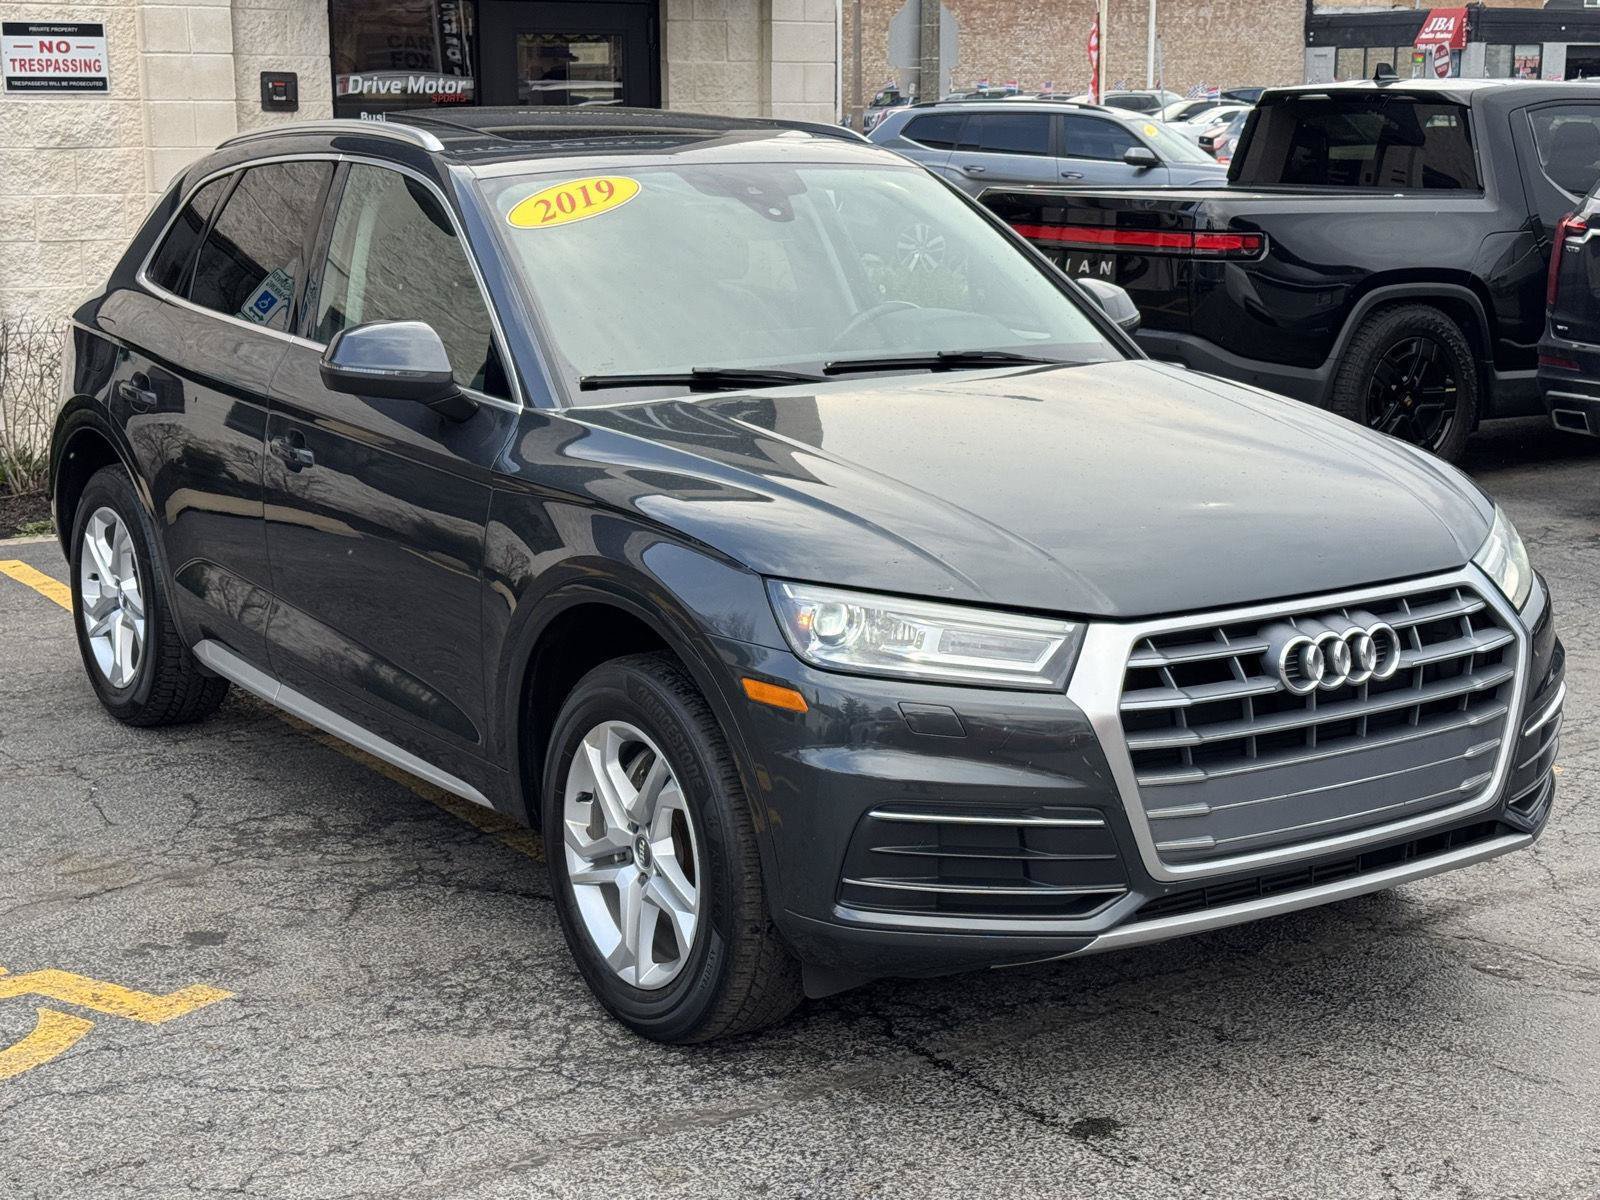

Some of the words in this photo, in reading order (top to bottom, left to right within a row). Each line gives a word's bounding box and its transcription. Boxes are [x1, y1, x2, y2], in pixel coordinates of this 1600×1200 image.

[1424, 16, 1456, 33] JBA
[38, 40, 71, 54] NO
[9, 58, 102, 73] TRESPASSING
[407, 75, 467, 94] Motor
[432, 93, 467, 103] SPORTS
[533, 179, 615, 223] 2019
